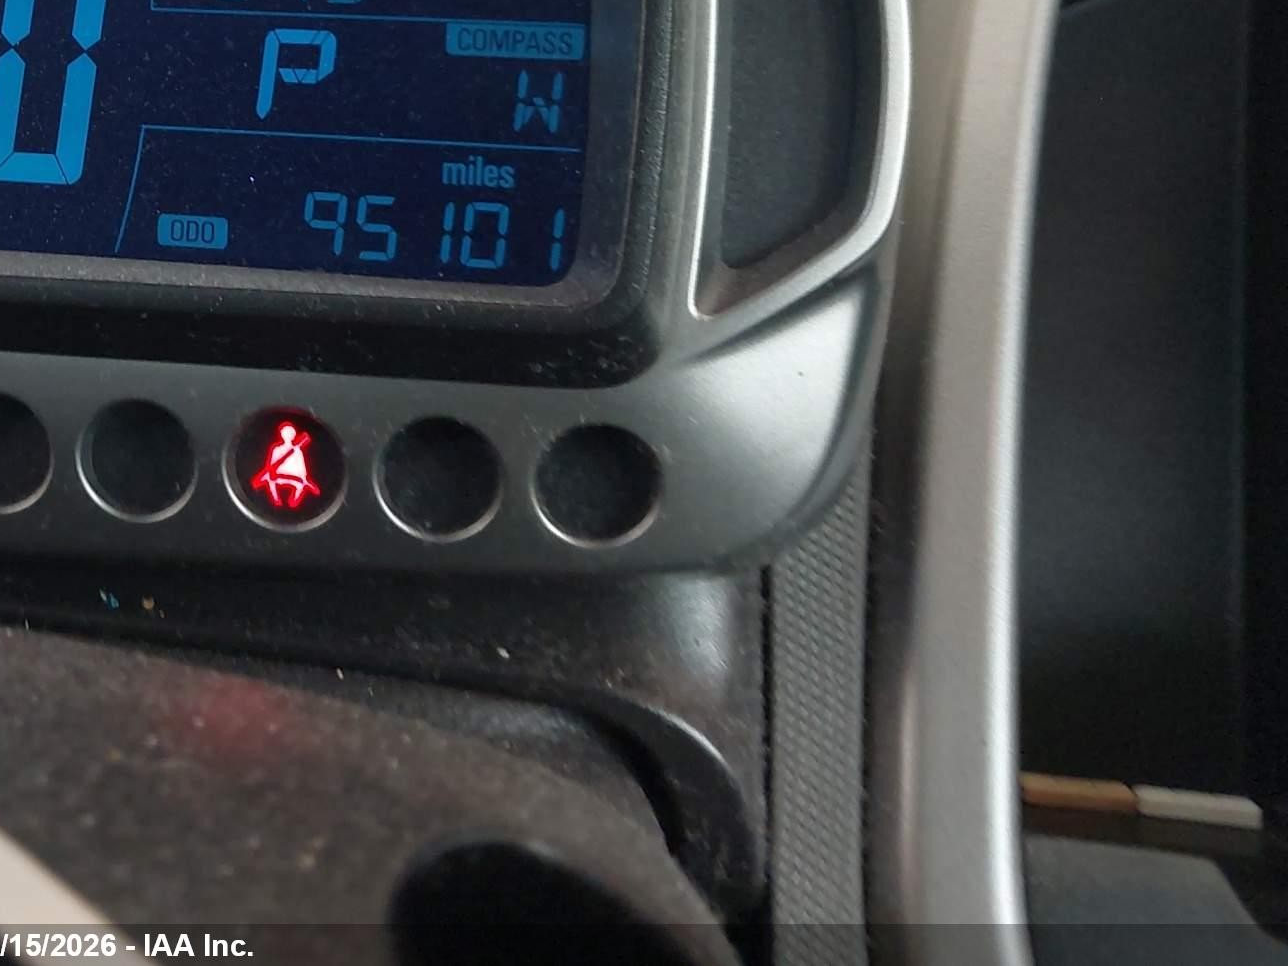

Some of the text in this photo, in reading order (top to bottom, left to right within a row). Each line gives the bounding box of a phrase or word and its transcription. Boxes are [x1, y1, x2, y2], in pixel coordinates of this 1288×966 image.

[457, 27, 573, 55] COMPASS
[256, 28, 336, 120] P
[513, 69, 564, 133] W
[442, 157, 515, 189] miles
[170, 219, 215, 244] ODO
